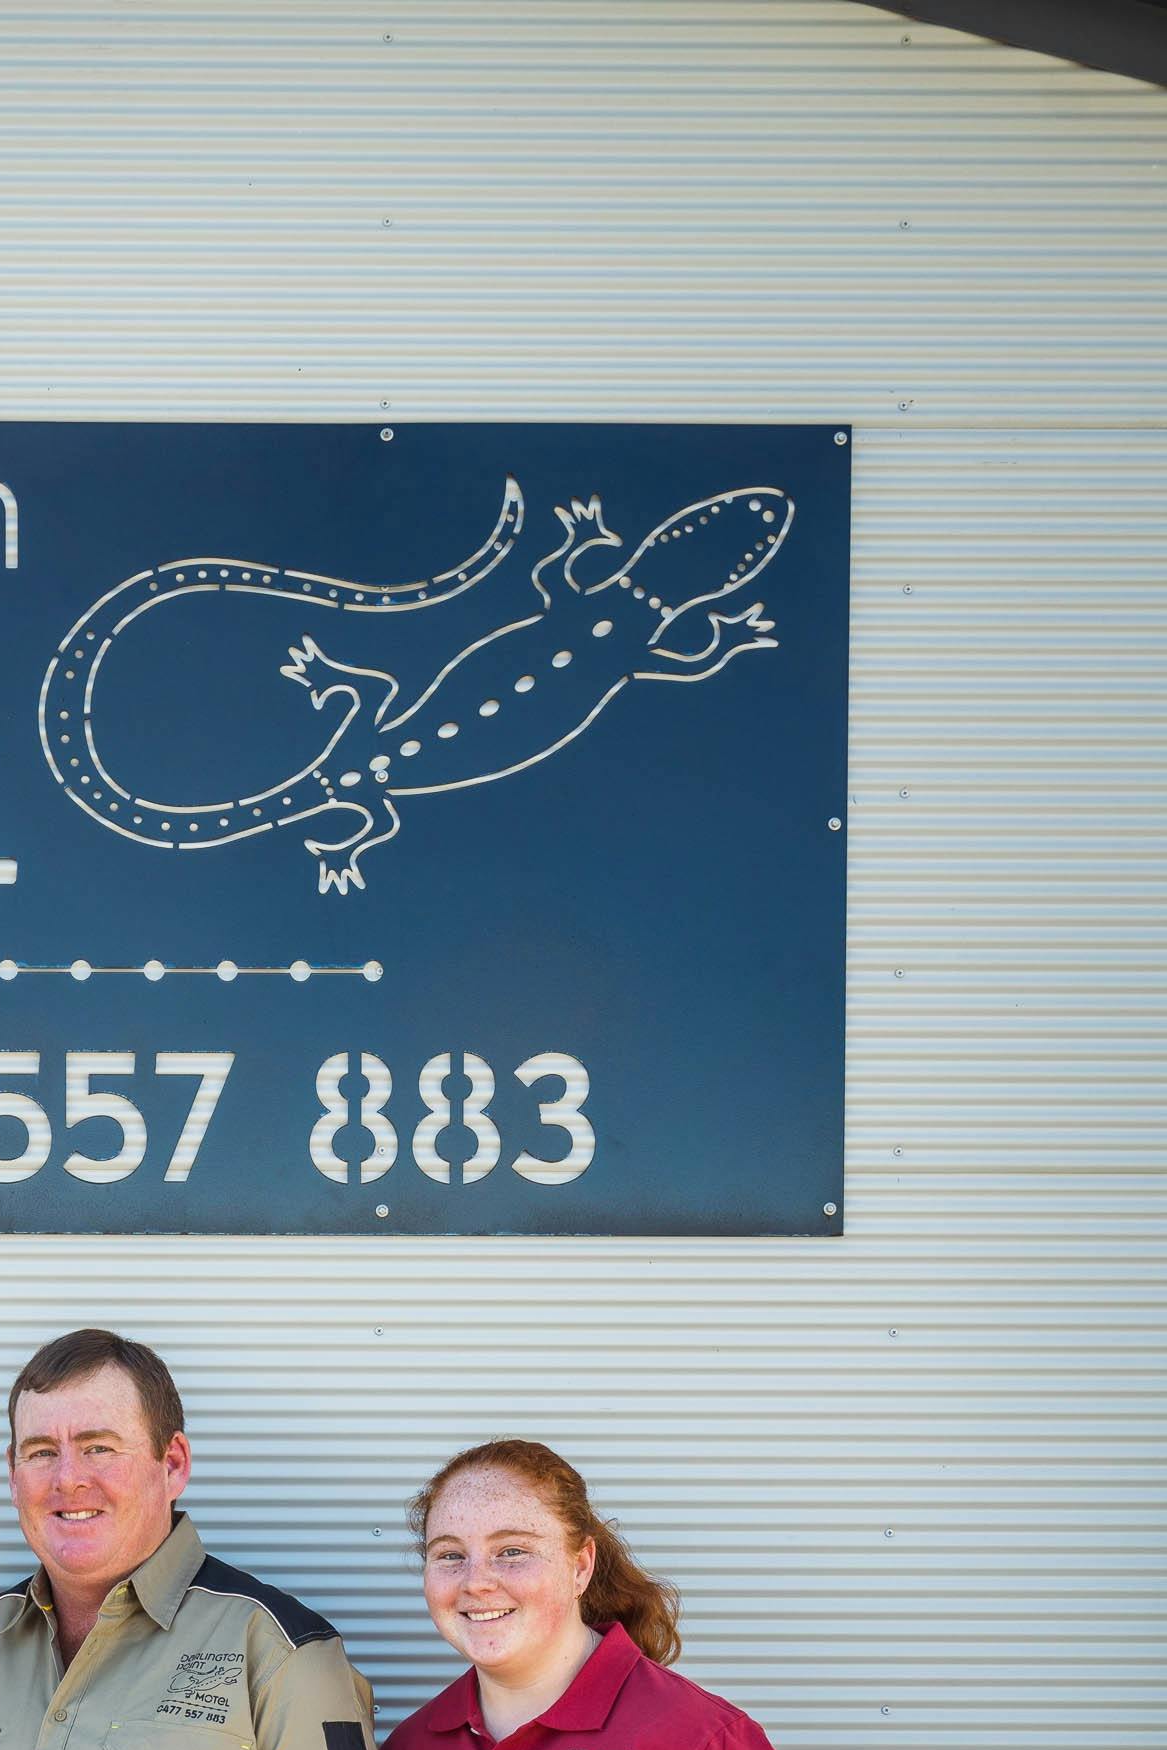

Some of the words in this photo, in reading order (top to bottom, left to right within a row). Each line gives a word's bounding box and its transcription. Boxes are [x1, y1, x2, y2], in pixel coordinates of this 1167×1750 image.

[309, 1051, 596, 1185] 883
[157, 1705, 182, 1716] 0477
[184, 1708, 204, 1719] 557
[206, 1712, 226, 1724] 883
